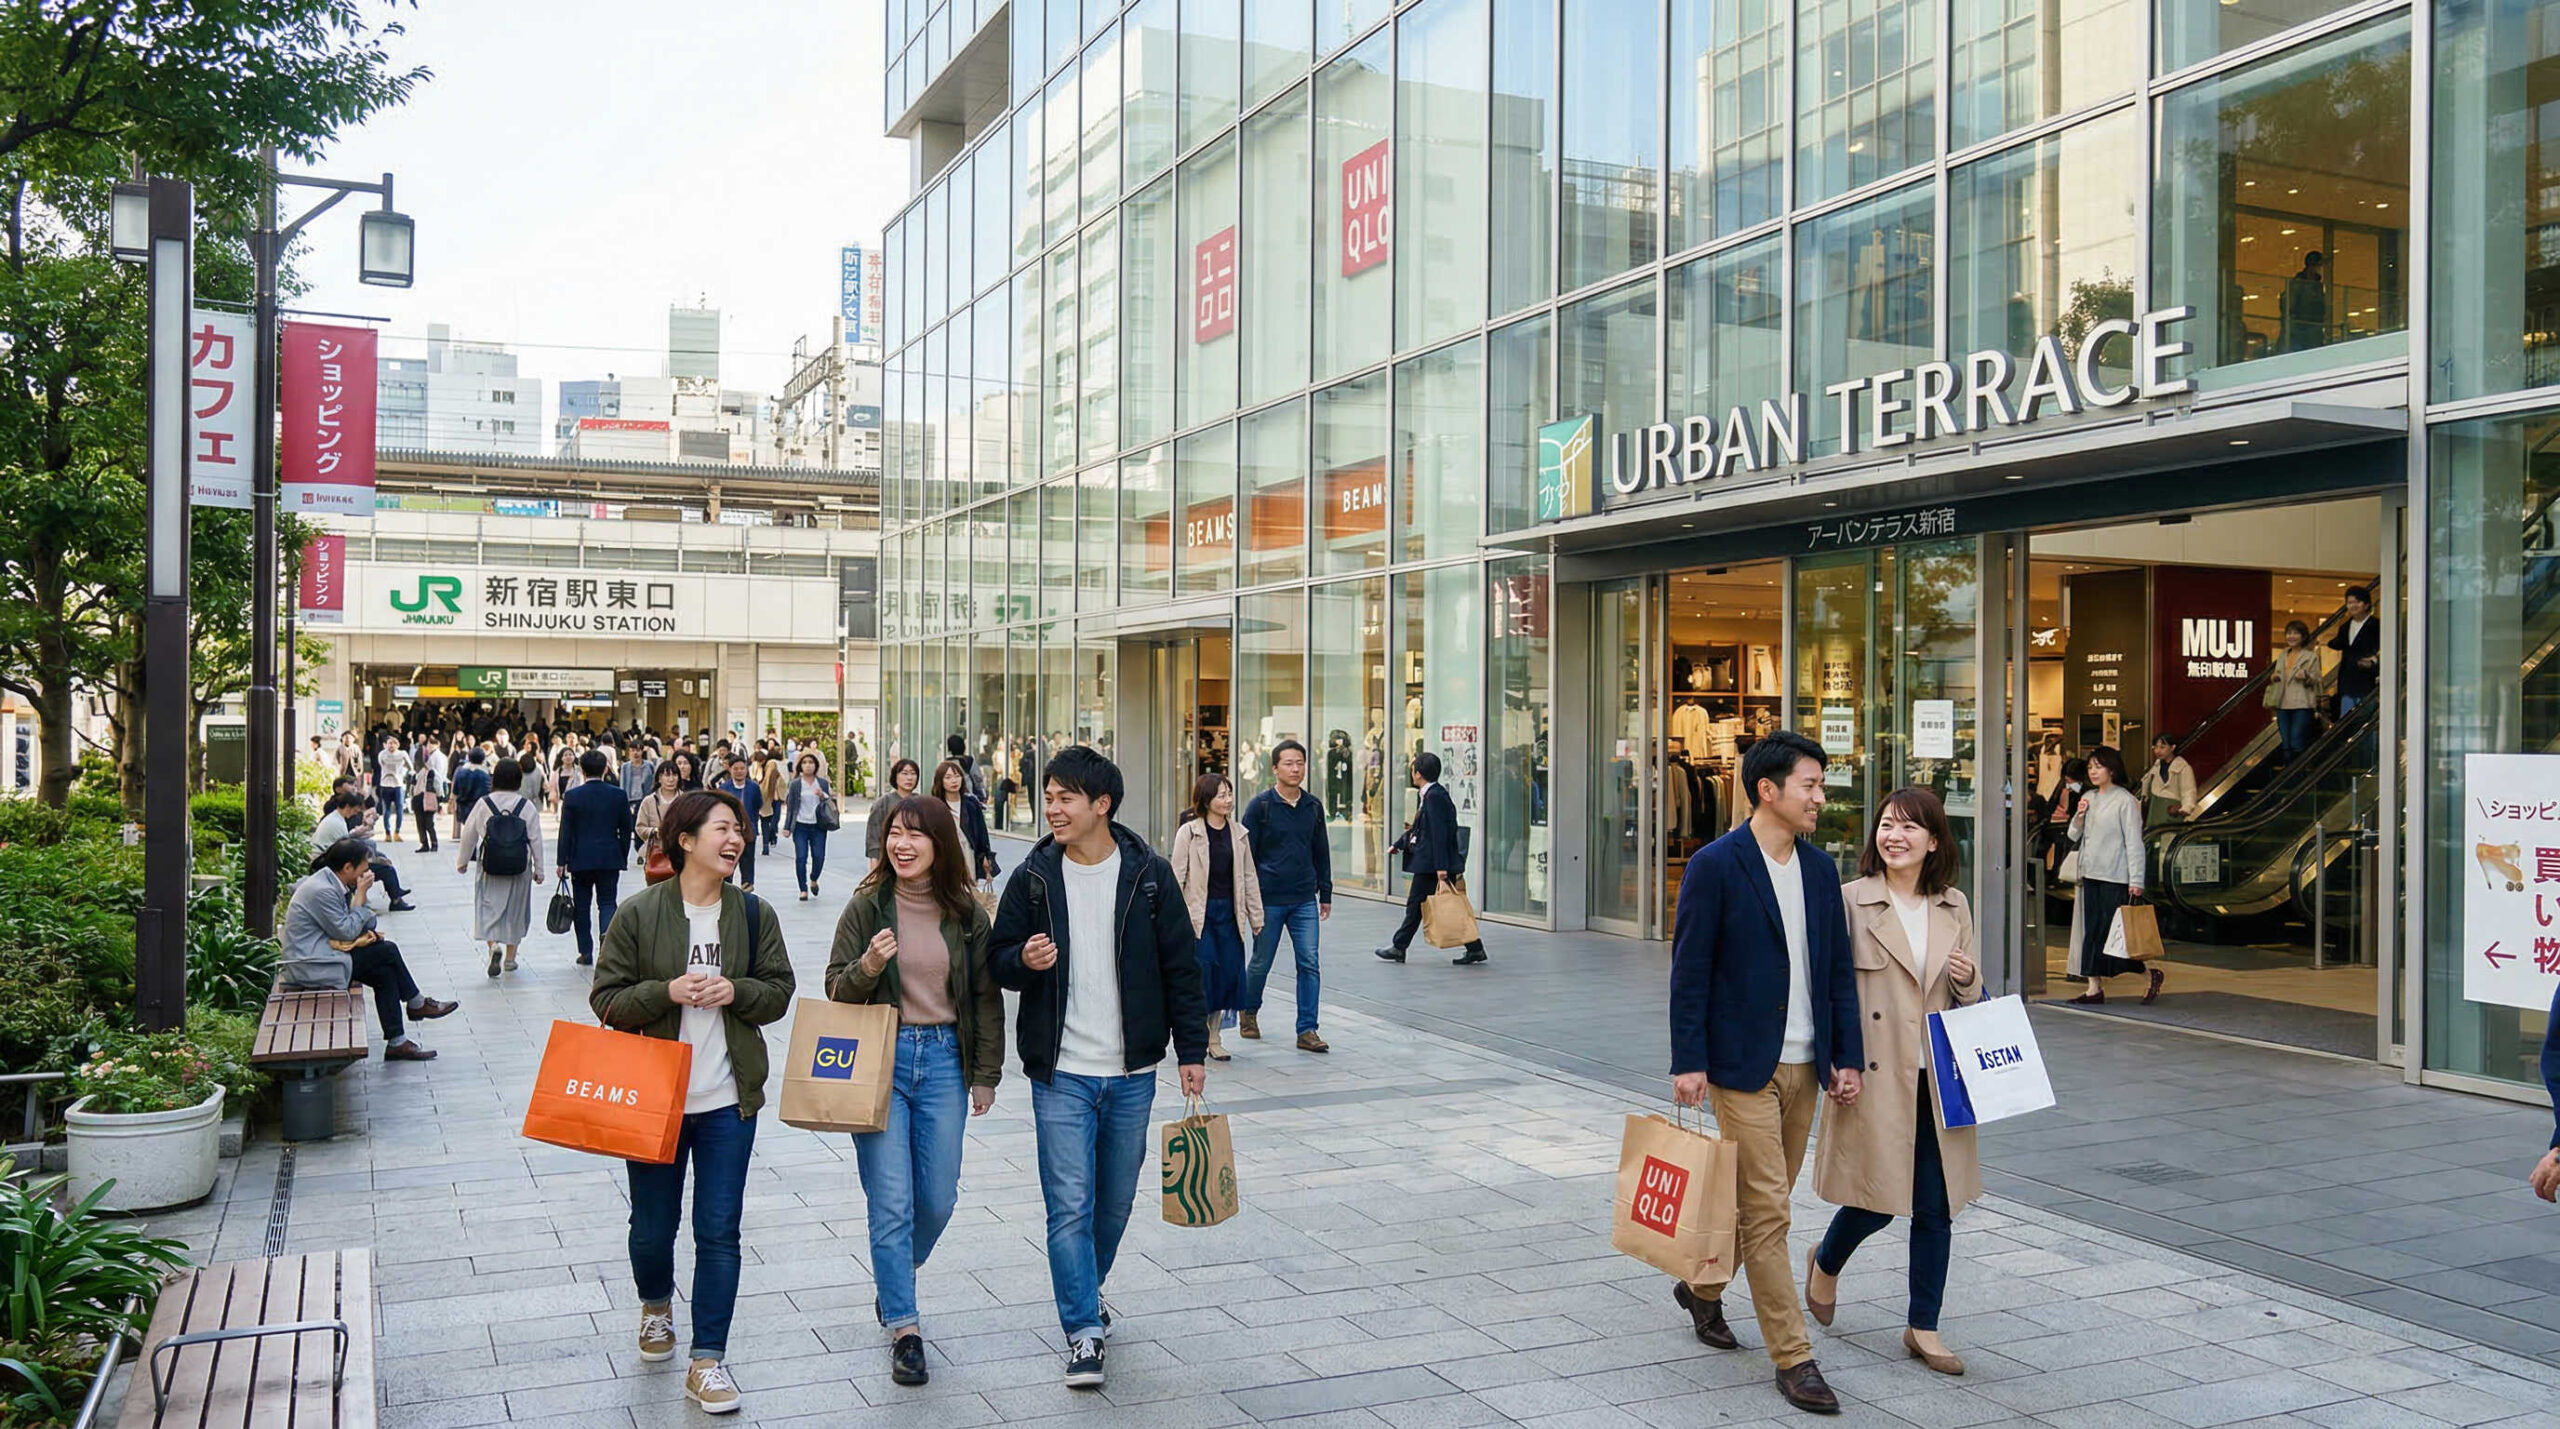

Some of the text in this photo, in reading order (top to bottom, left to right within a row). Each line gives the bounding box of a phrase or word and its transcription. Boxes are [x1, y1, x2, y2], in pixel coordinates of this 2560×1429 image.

[1348, 154, 1388, 210] UNI
[1347, 205, 1388, 263] QLO
[1201, 241, 1231, 285] ユニ
[1200, 284, 1231, 330] クロ
[316, 338, 343, 474] ショッピング
[1612, 305, 2198, 494] URBAN TERRACE
[1342, 482, 1387, 513] BEAM
[1187, 512, 1233, 547] BEAMS
[1807, 507, 1956, 550] アーバンテラス新宿
[390, 575, 463, 613] JR
[485, 575, 675, 610] 新宿駅東口
[485, 612, 676, 632] SHINJUKU STATION
[2181, 618, 2253, 659] MUJI
[478, 671, 503, 686] JR
[2491, 800, 2560, 820] ショッピ
[816, 1047, 855, 1068] GU
[566, 1079, 639, 1106] BEAMS
[1645, 1165, 1681, 1199] UNI
[1638, 1193, 1675, 1226] QLO
